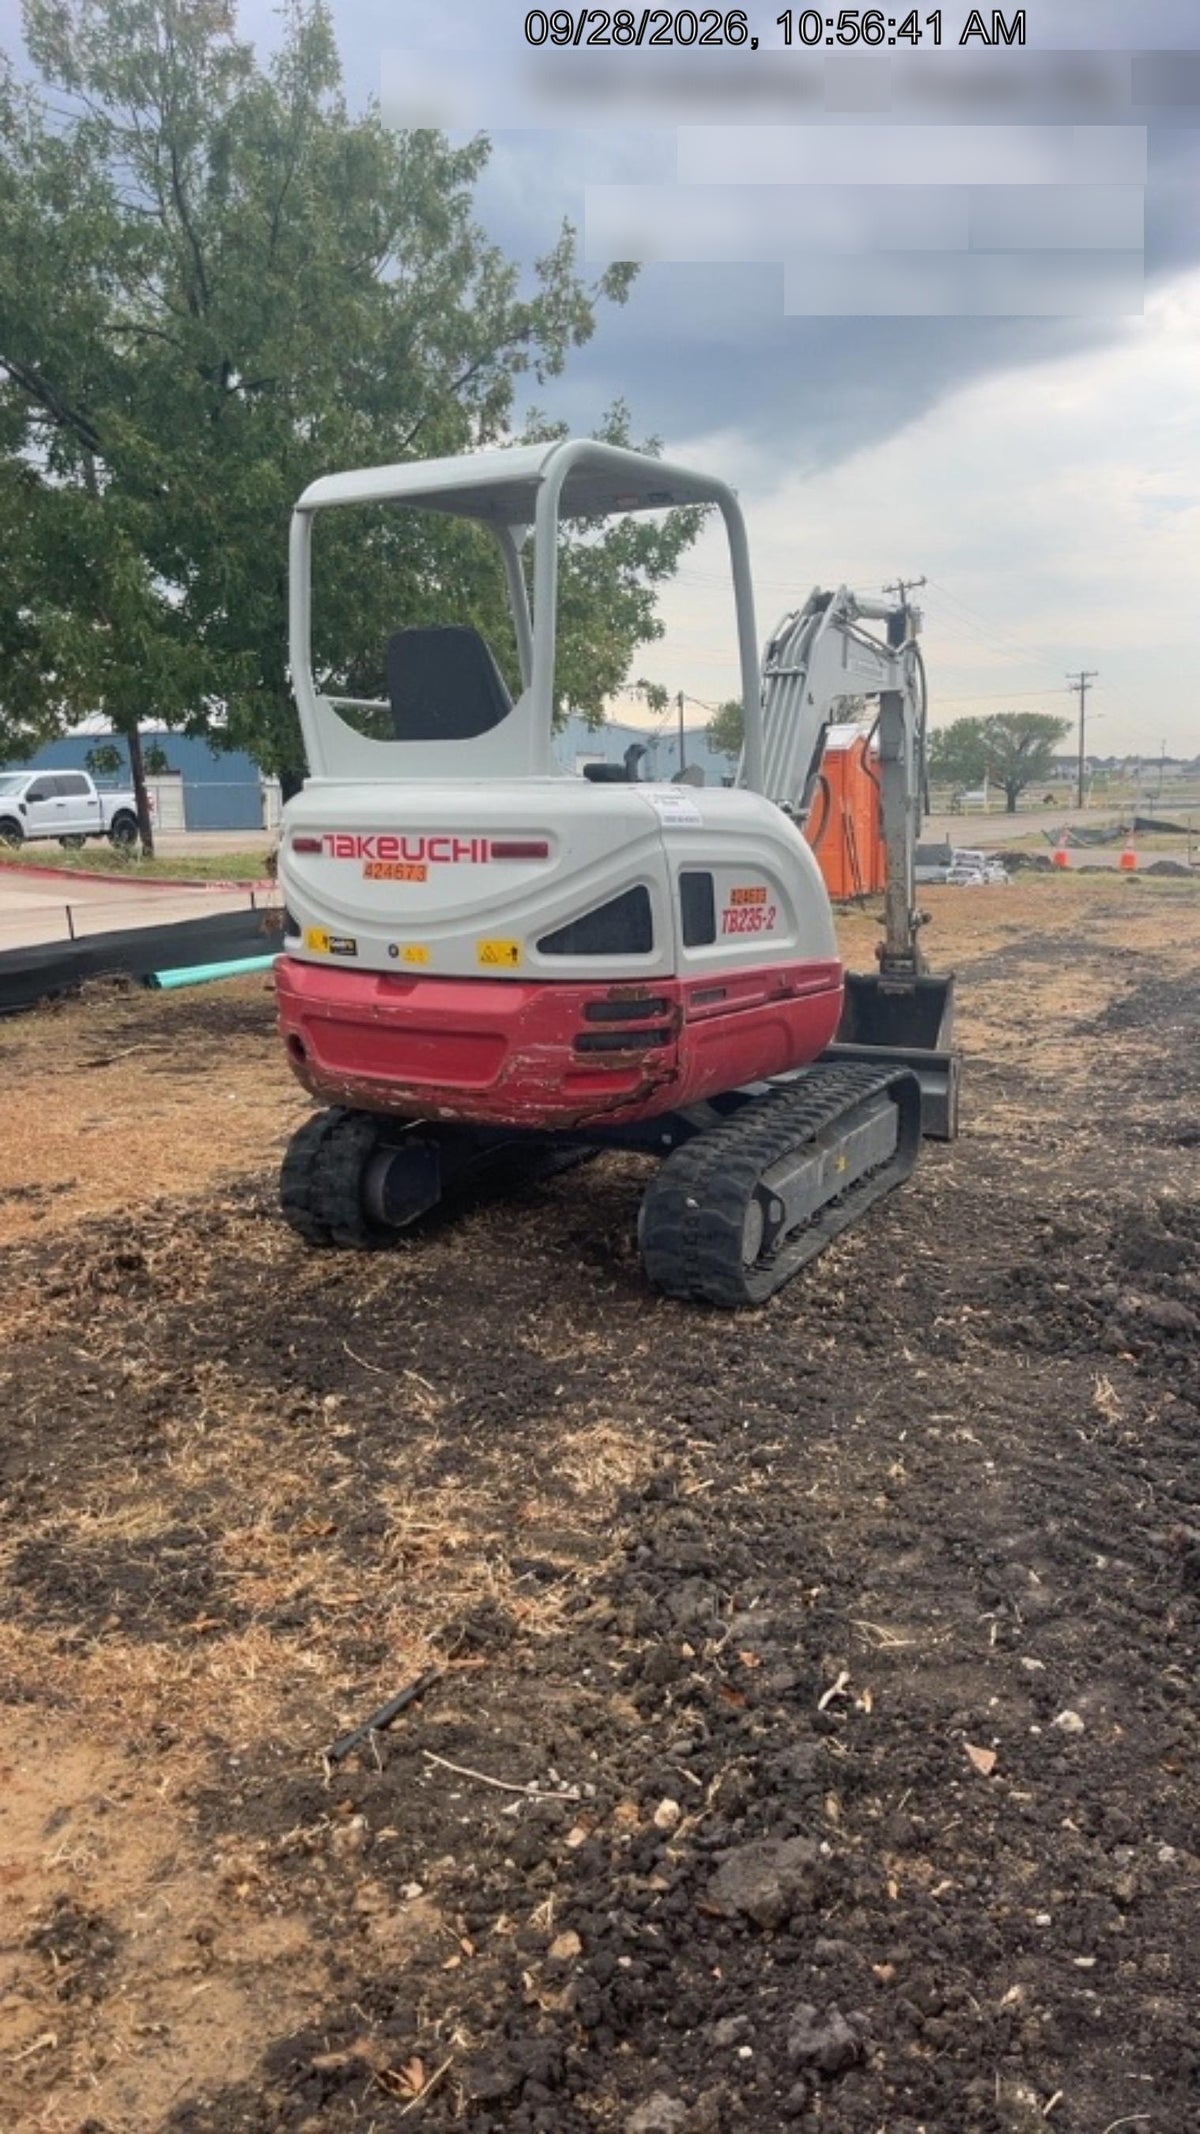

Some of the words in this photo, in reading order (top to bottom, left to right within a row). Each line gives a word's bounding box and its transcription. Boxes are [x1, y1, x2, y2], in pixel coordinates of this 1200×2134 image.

[322, 834, 488, 863] TAKEUCHI
[364, 862, 427, 881] 424673
[722, 906, 777, 934] TB235-2
